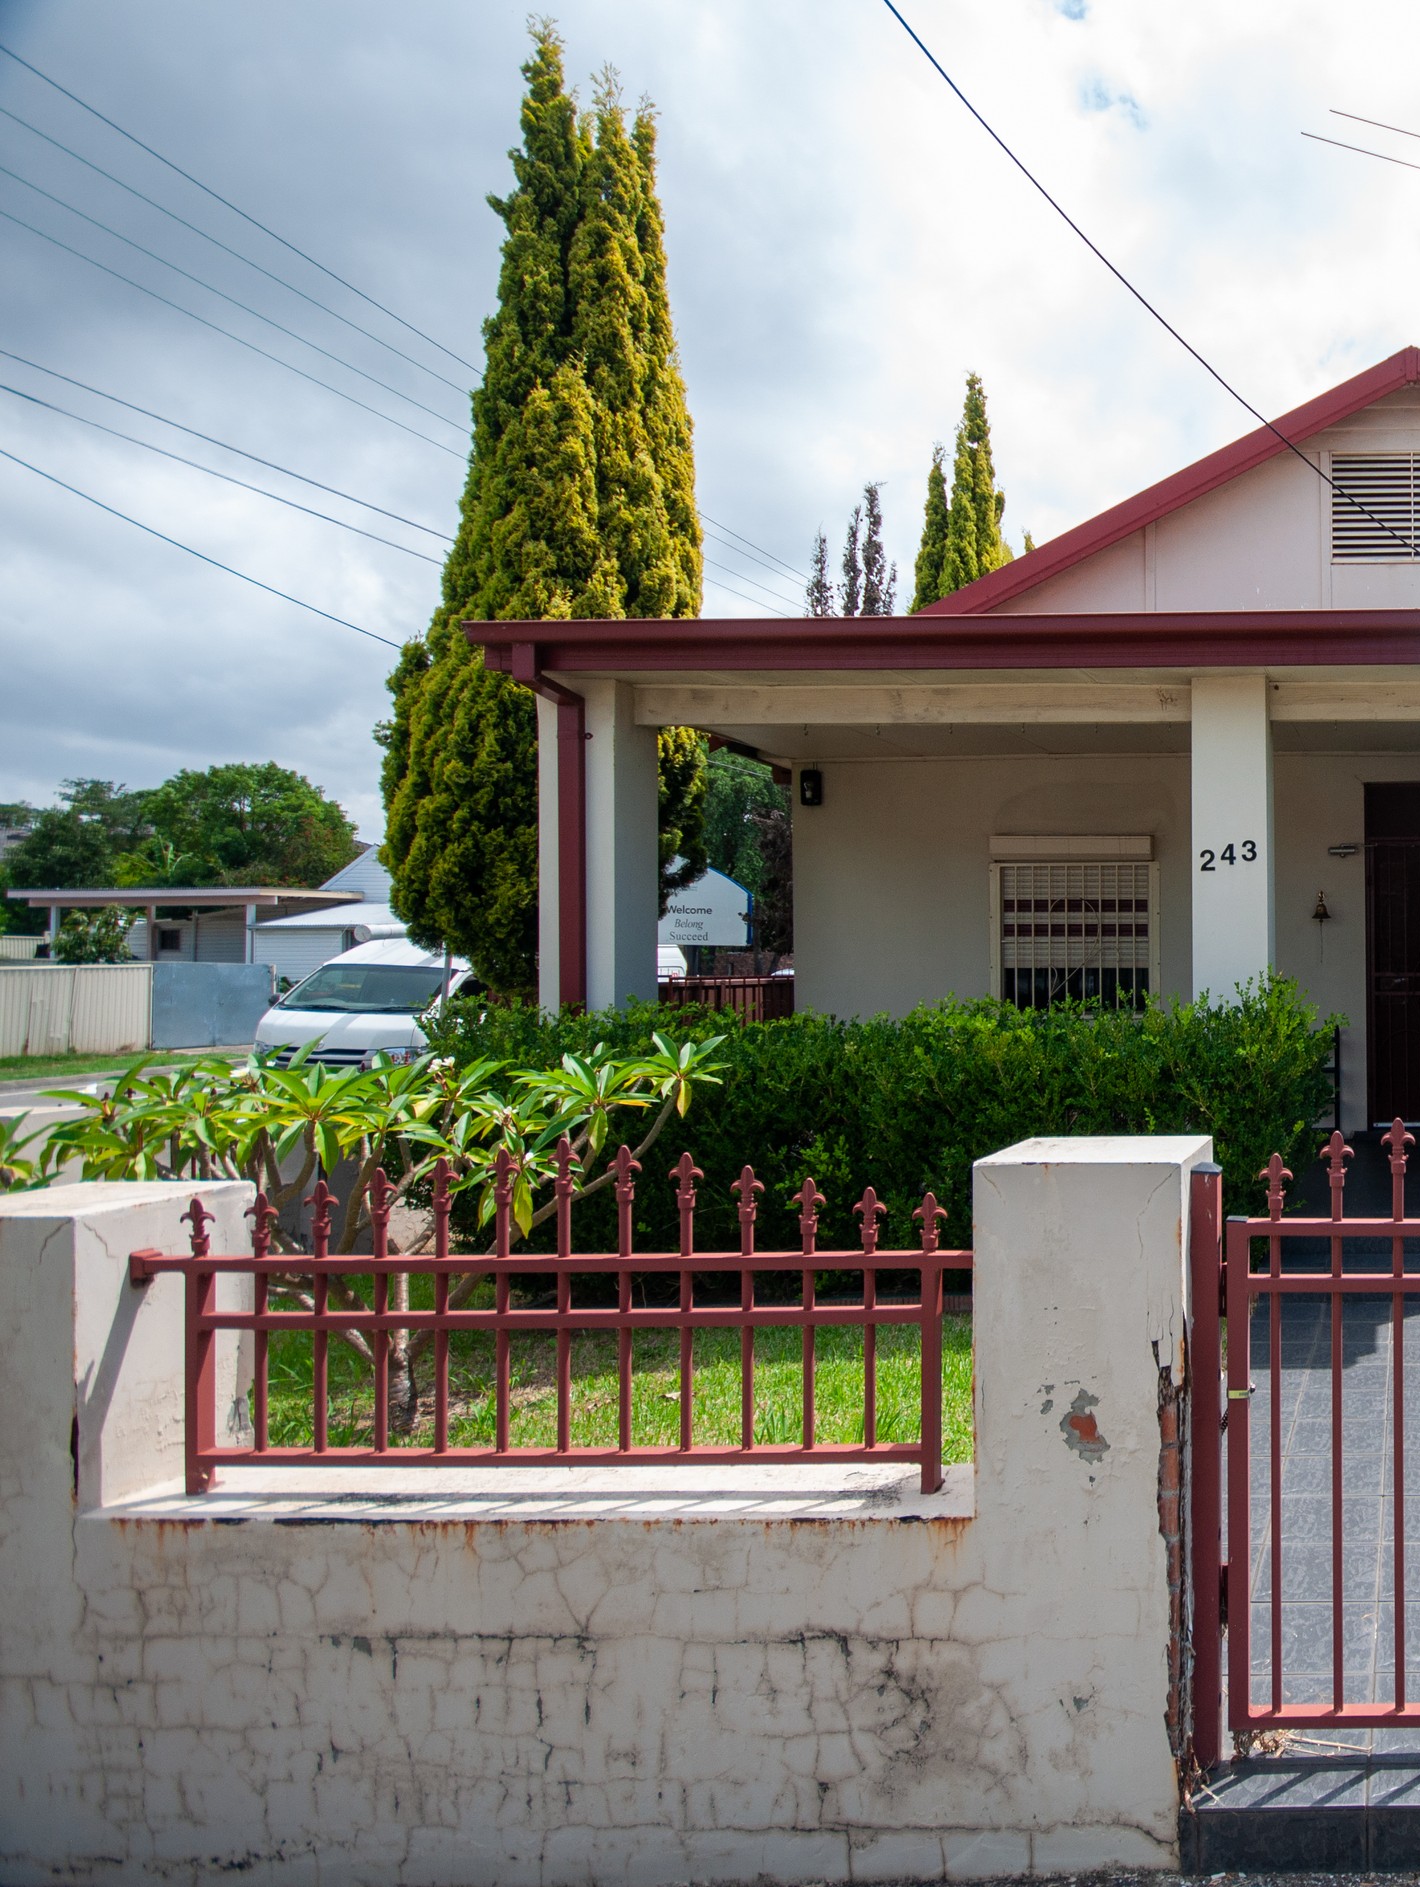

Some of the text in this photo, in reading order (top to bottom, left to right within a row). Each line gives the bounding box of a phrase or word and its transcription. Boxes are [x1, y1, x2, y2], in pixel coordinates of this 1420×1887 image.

[1200, 840, 1258, 871] 243
[668, 905, 713, 915] Welcome
[674, 918, 704, 930] Belong
[669, 931, 709, 942] Succeed
